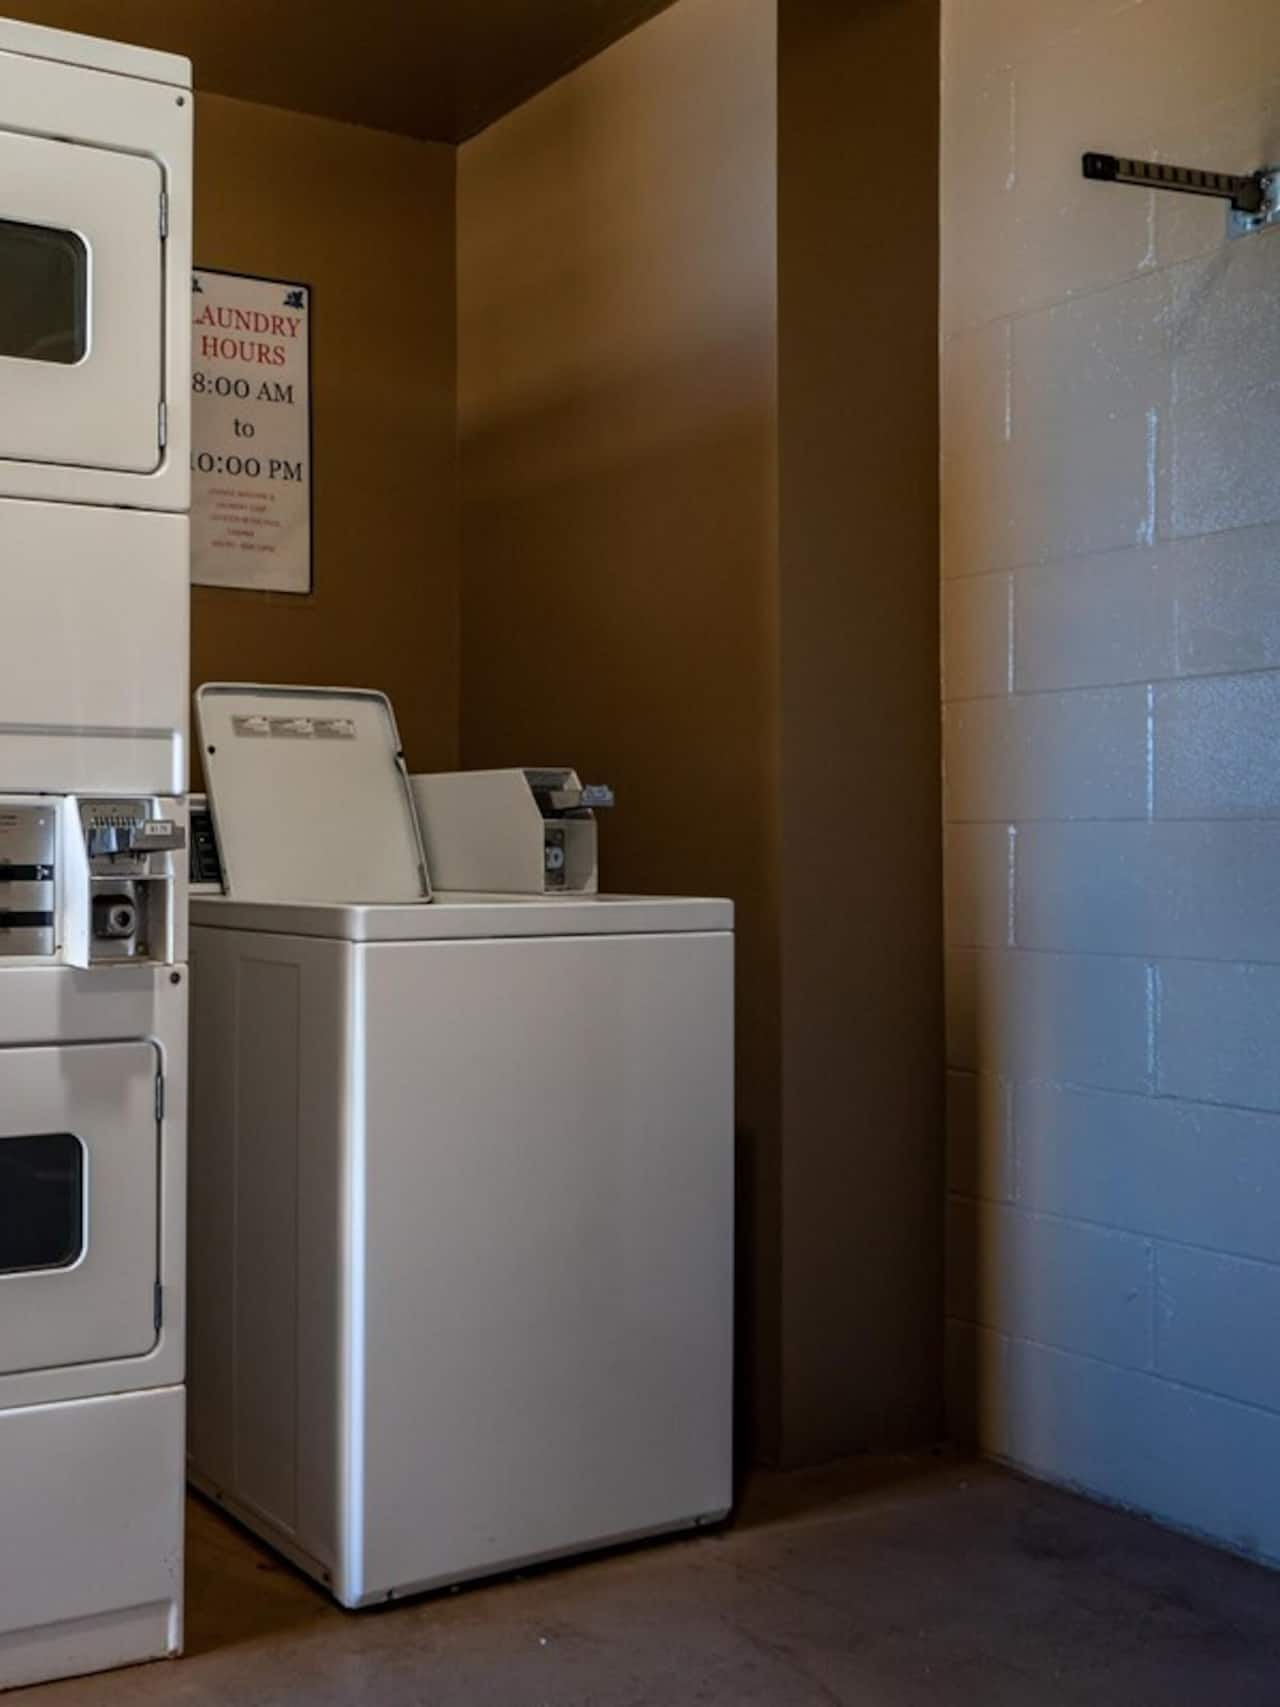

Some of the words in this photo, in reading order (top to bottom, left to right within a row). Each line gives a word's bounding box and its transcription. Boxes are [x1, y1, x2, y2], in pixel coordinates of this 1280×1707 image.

[202, 335, 287, 367] HOURS
[191, 371, 251, 399] 8:00
[256, 381, 296, 405] AM
[233, 417, 256, 438] to
[269, 458, 304, 482] PM
